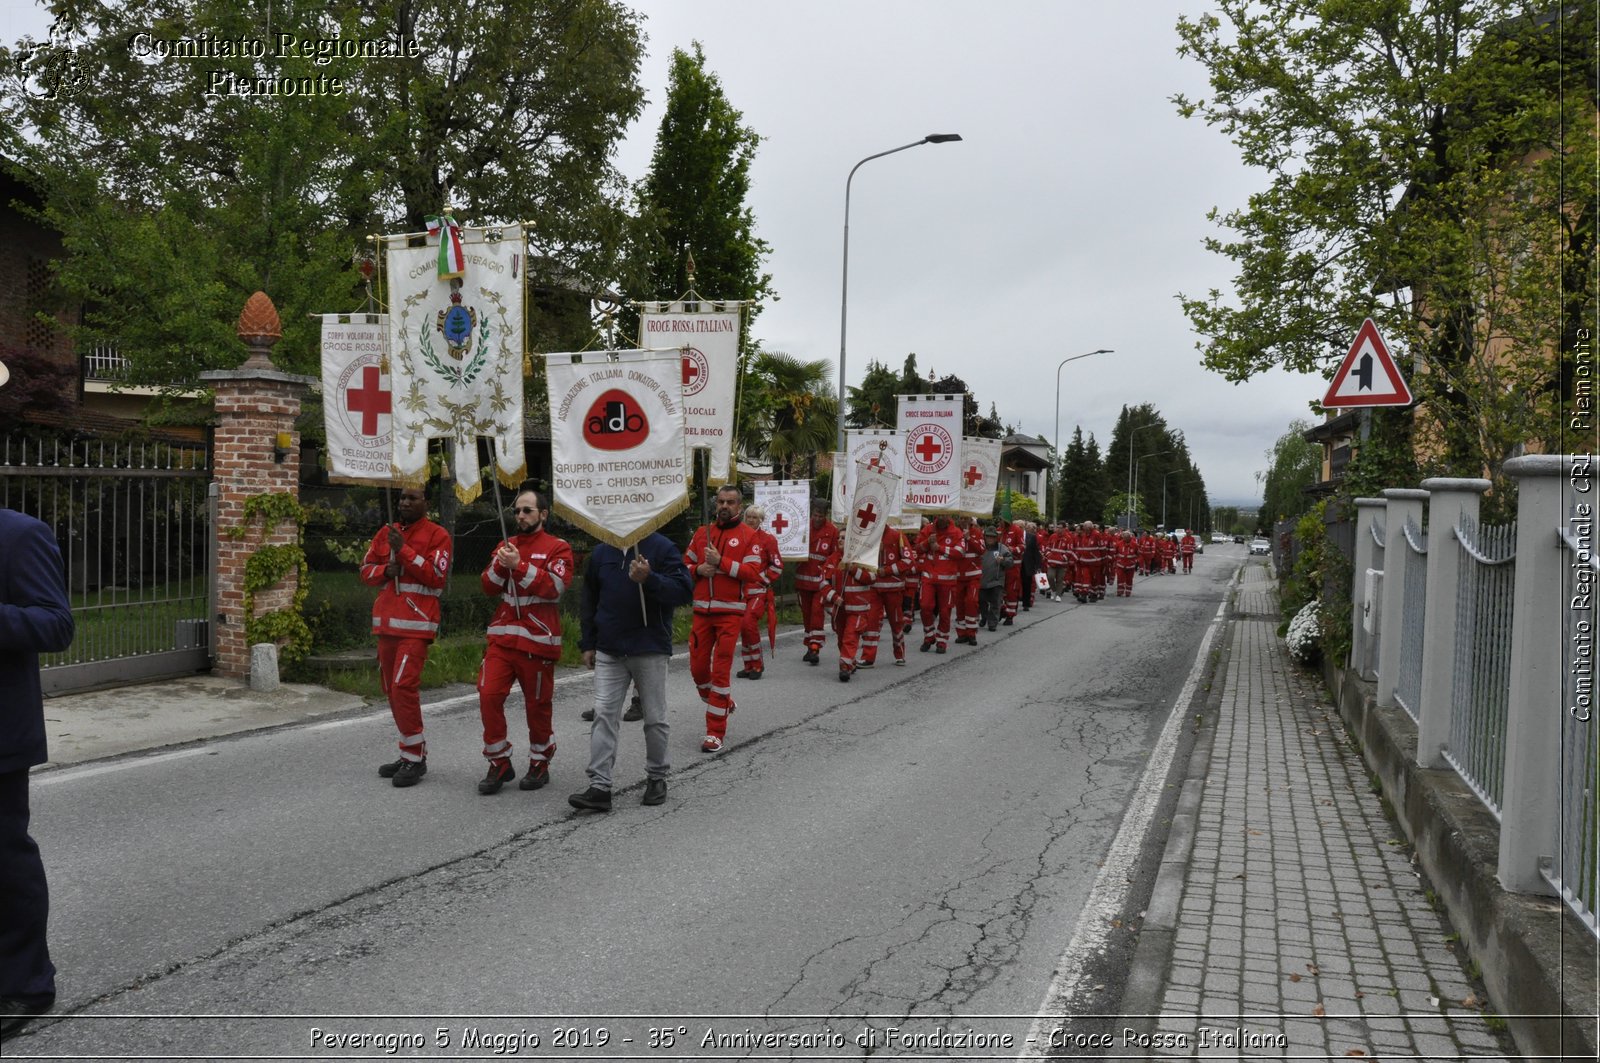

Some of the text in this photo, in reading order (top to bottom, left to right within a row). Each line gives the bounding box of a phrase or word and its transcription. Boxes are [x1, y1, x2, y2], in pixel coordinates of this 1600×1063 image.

[409, 259, 438, 279] COMUN
[647, 320, 733, 332] CROCE ROSSA ITALIANA
[323, 342, 353, 352] CROCE
[355, 342, 382, 352] ROSSA
[558, 369, 678, 422] ASSOCIAZIONE ITALIANA DONATORI ORGANI
[688, 407, 716, 416] LOCALE
[588, 402, 644, 435] aido
[701, 427, 723, 437] BOSCO
[908, 426, 931, 453] CONVENZIONE
[940, 430, 951, 454] GINEVRA
[342, 448, 393, 461] DELEGAZIONE
[345, 459, 392, 473] PEVERAGN
[556, 458, 683, 473] GRUPPO INTERCOMUNALE
[916, 464, 935, 472] AGOSTO
[556, 479, 593, 489] BOVES
[607, 477, 648, 488] CHIUSA
[652, 473, 684, 486] PESIO
[586, 493, 655, 506] PEVERAGNO
